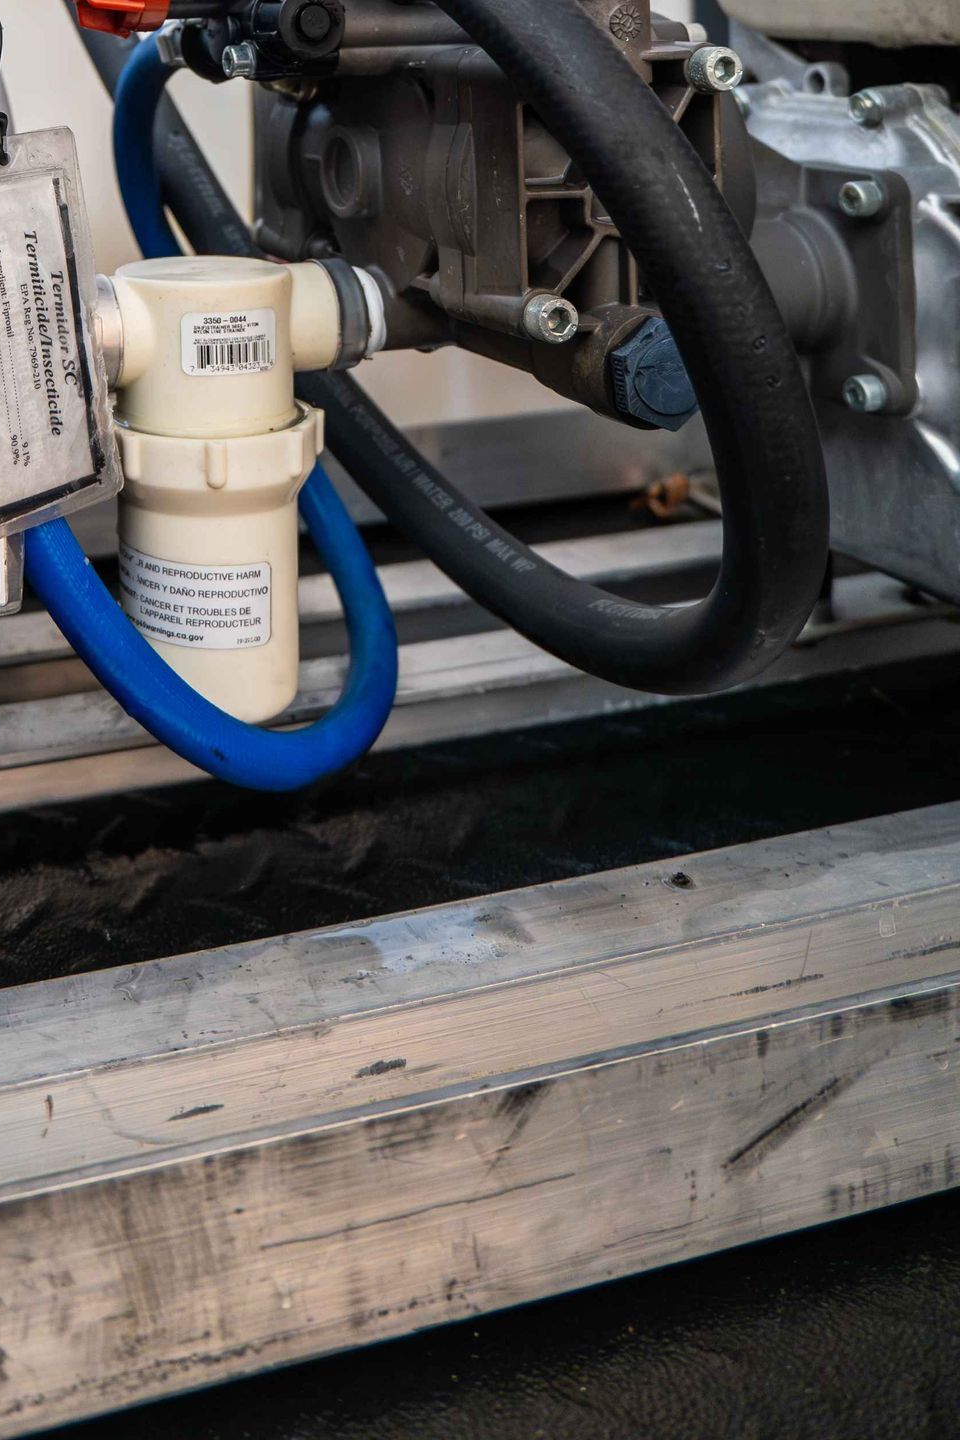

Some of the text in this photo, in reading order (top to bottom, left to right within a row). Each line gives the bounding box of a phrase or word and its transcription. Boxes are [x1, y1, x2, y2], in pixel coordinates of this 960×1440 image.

[20, 283, 41, 390] EPA Reg No: 7969-210
[24, 231, 63, 436] Termiticide/Insecticide
[50, 270, 77, 386] Termidor SC
[2, 301, 15, 338] Fipronil
[22, 442, 31, 467] 9.1%
[10, 434, 20, 465] 90.9%
[145, 563, 160, 573] AND
[162, 568, 234, 580] REPRODUCTIVE
[236, 570, 261, 580] HARM
[140, 594, 171, 611] CANCER
[187, 606, 236, 617] TROUBLES
[239, 607, 251, 615] DE
[162, 584, 168, 592] Y
[170, 585, 195, 597] DAÑO
[198, 586, 268, 598] REPRODUCTIVO
[140, 606, 261, 628] L'APPAREIL REPRODUCTEUR
